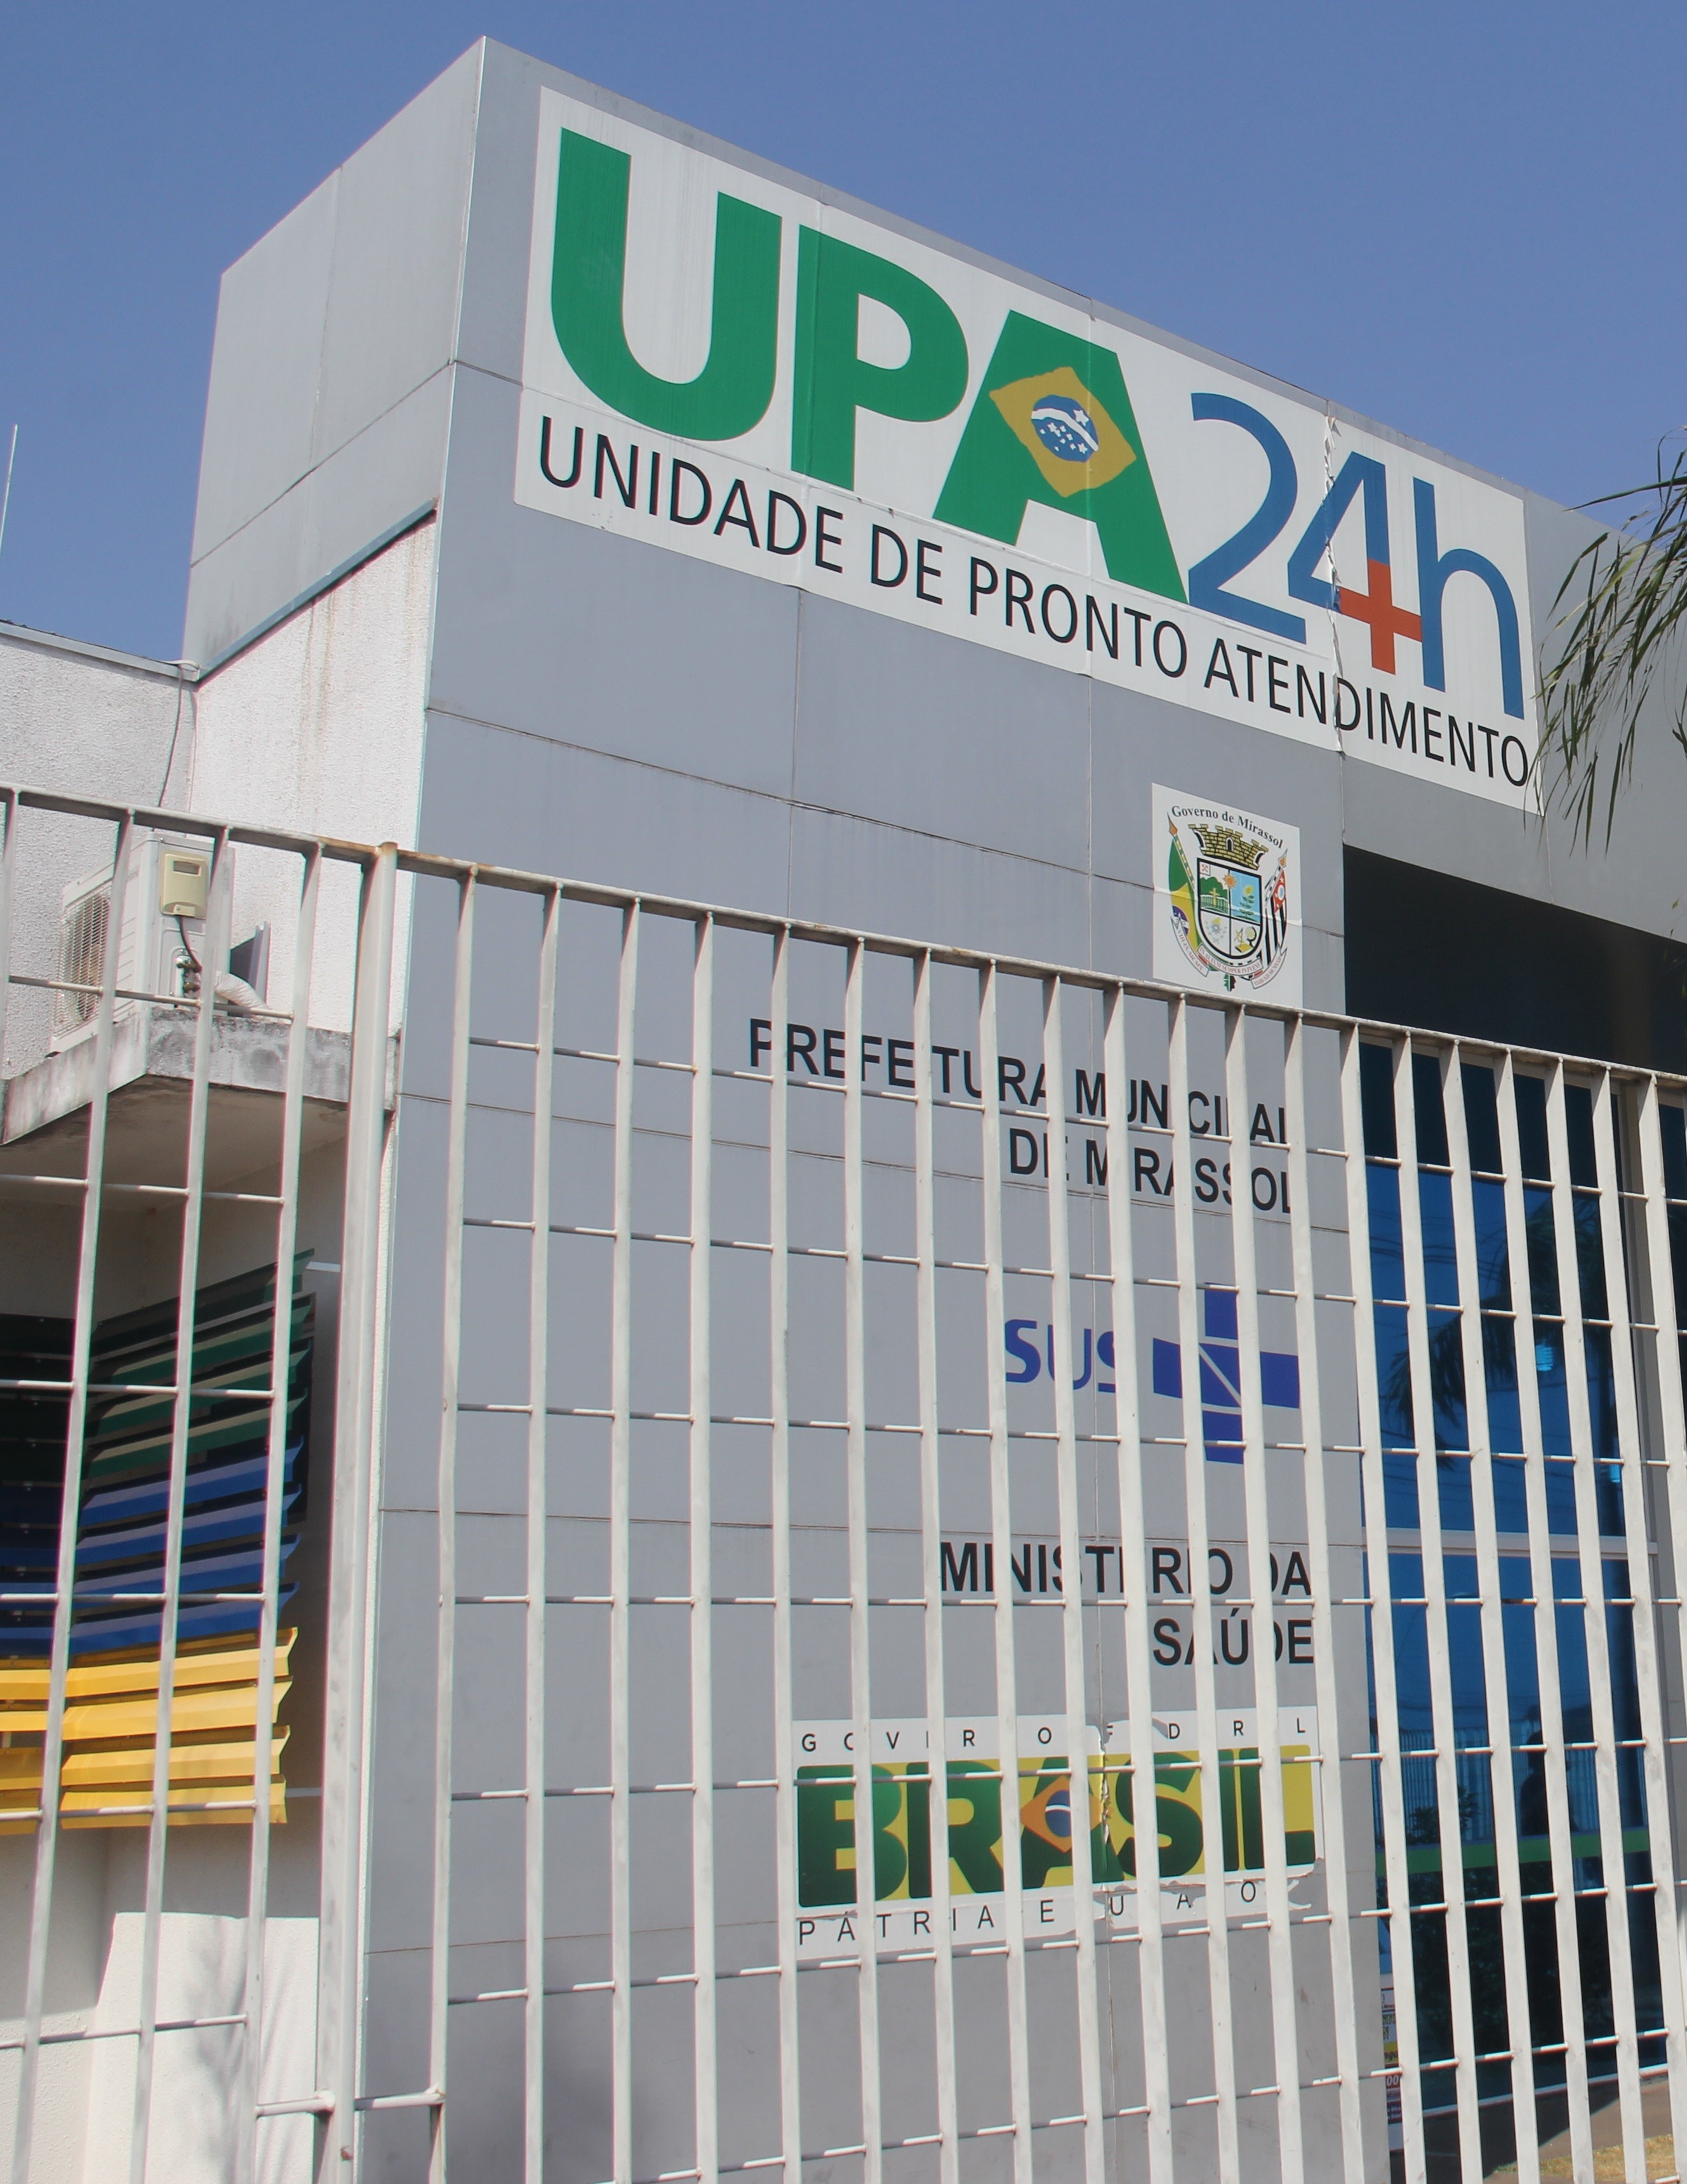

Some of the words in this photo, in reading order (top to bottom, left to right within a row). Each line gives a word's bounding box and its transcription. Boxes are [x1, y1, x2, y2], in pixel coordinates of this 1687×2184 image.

[551, 127, 1188, 604] UPA
[1189, 392, 1525, 720] 24h
[540, 415, 844, 574] UNIDADE
[870, 523, 943, 606] DE
[970, 556, 1188, 678] PRONTO
[1204, 637, 1529, 787] ATENDIMENTO
[1171, 805, 1218, 819] Governo
[1222, 811, 1235, 824] de
[1237, 815, 1283, 848] Mirassol
[797, 1745, 1316, 1908] BRASIL
